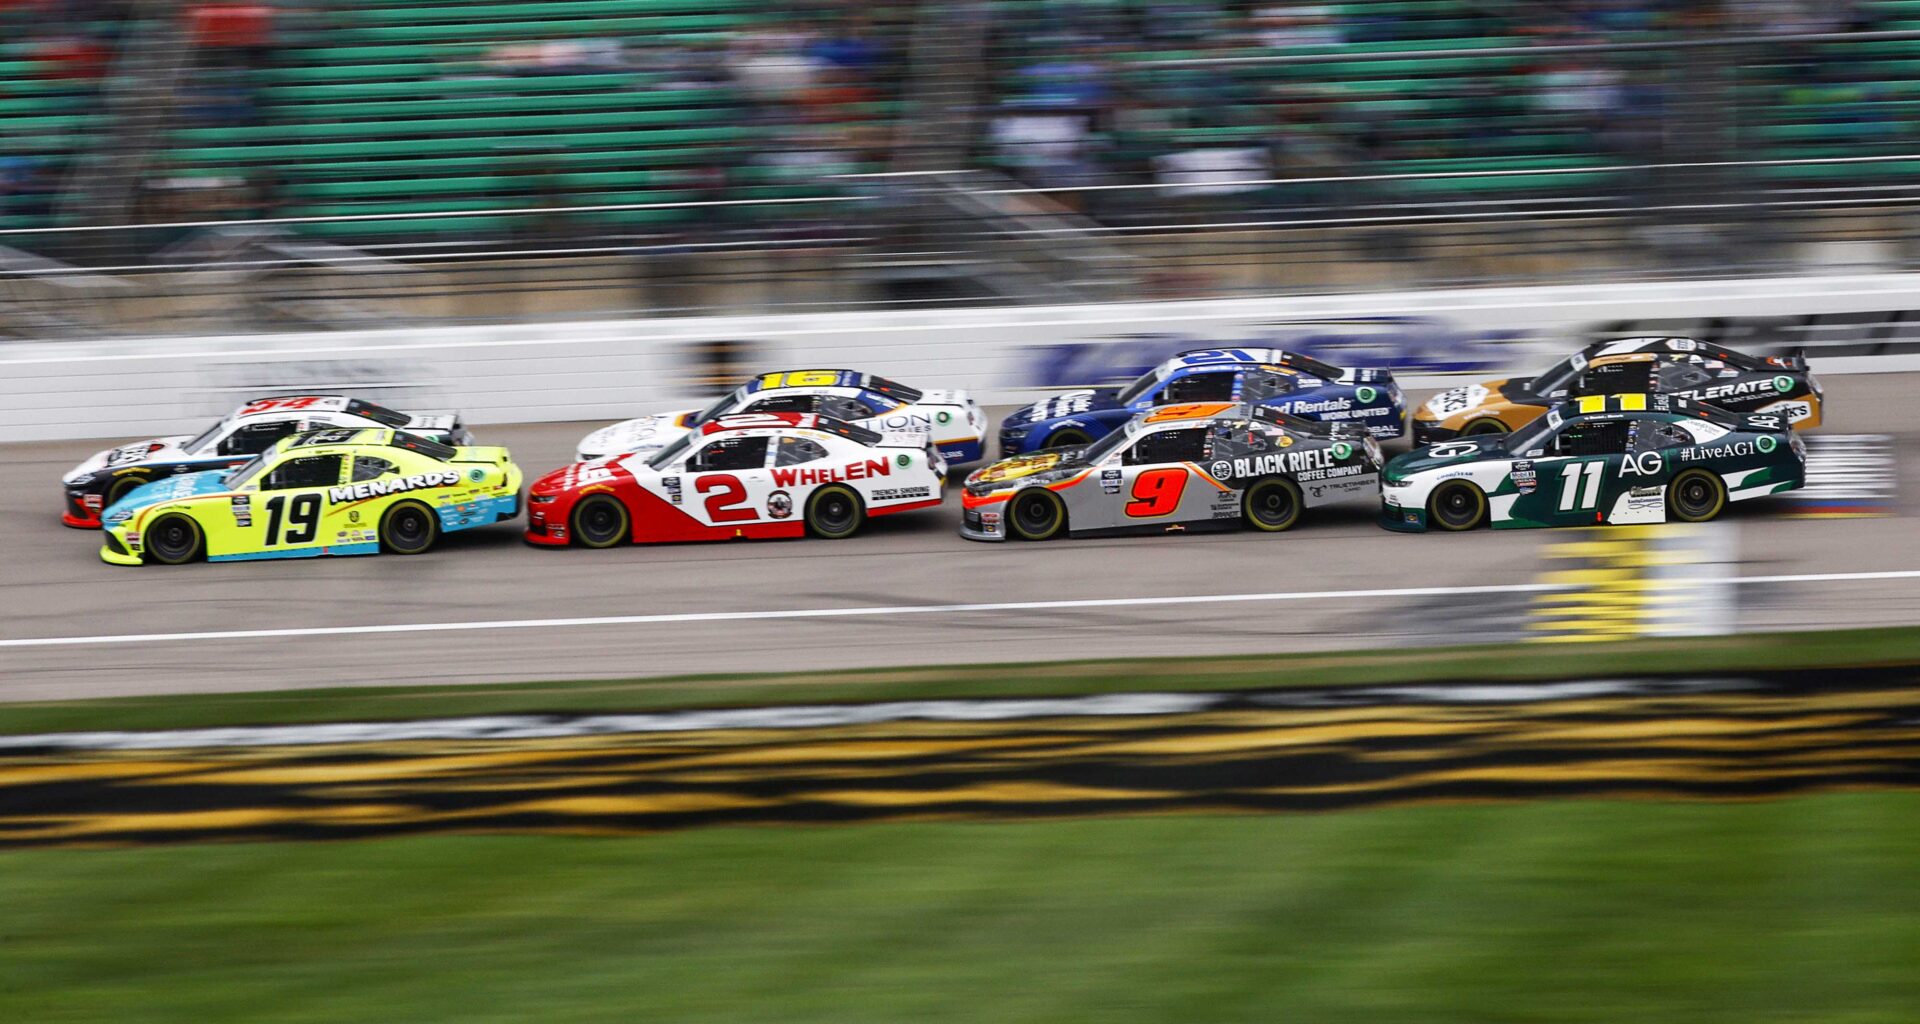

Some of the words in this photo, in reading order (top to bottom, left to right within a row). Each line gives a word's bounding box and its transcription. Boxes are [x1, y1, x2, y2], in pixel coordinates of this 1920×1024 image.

[1181, 349, 1256, 365] 21
[1293, 397, 1351, 414] Rentals
[1320, 411, 1351, 420] WORK
[1352, 407, 1390, 416] UNITED
[1233, 454, 1286, 479] BLACK
[1288, 448, 1335, 472] RIFLE
[1681, 441, 1755, 462] #LiveAG1
[328, 471, 461, 504] MENARDS
[769, 456, 891, 488] WHELEN
[1297, 469, 1326, 482] COFFEE
[1326, 464, 1363, 479] COMPANY
[1559, 461, 1604, 511] 11
[695, 473, 761, 523] 2
[900, 485, 930, 494] SHORING
[1125, 467, 1190, 518] 9
[264, 492, 322, 546] 19
